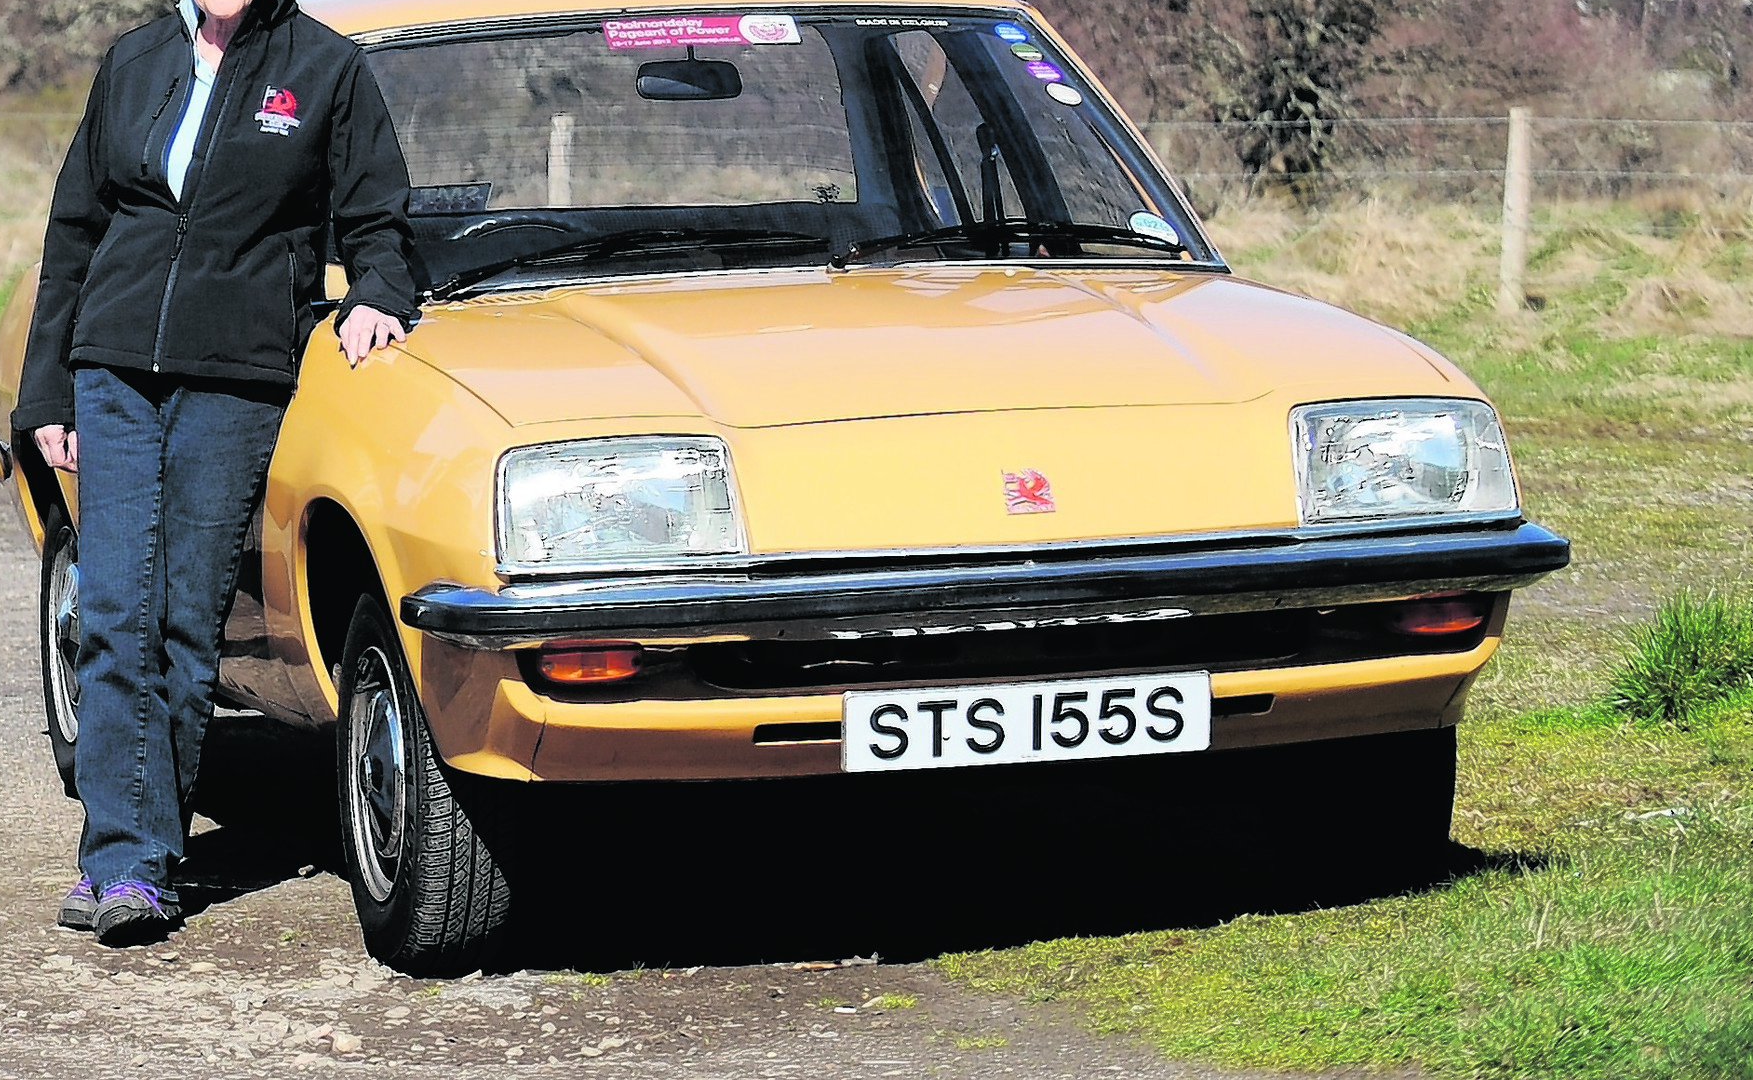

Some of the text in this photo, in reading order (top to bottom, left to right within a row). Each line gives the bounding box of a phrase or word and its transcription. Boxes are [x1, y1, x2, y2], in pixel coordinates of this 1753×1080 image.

[608, 26, 730, 39] Pageant of Power
[868, 686, 1184, 759] STS 155S
